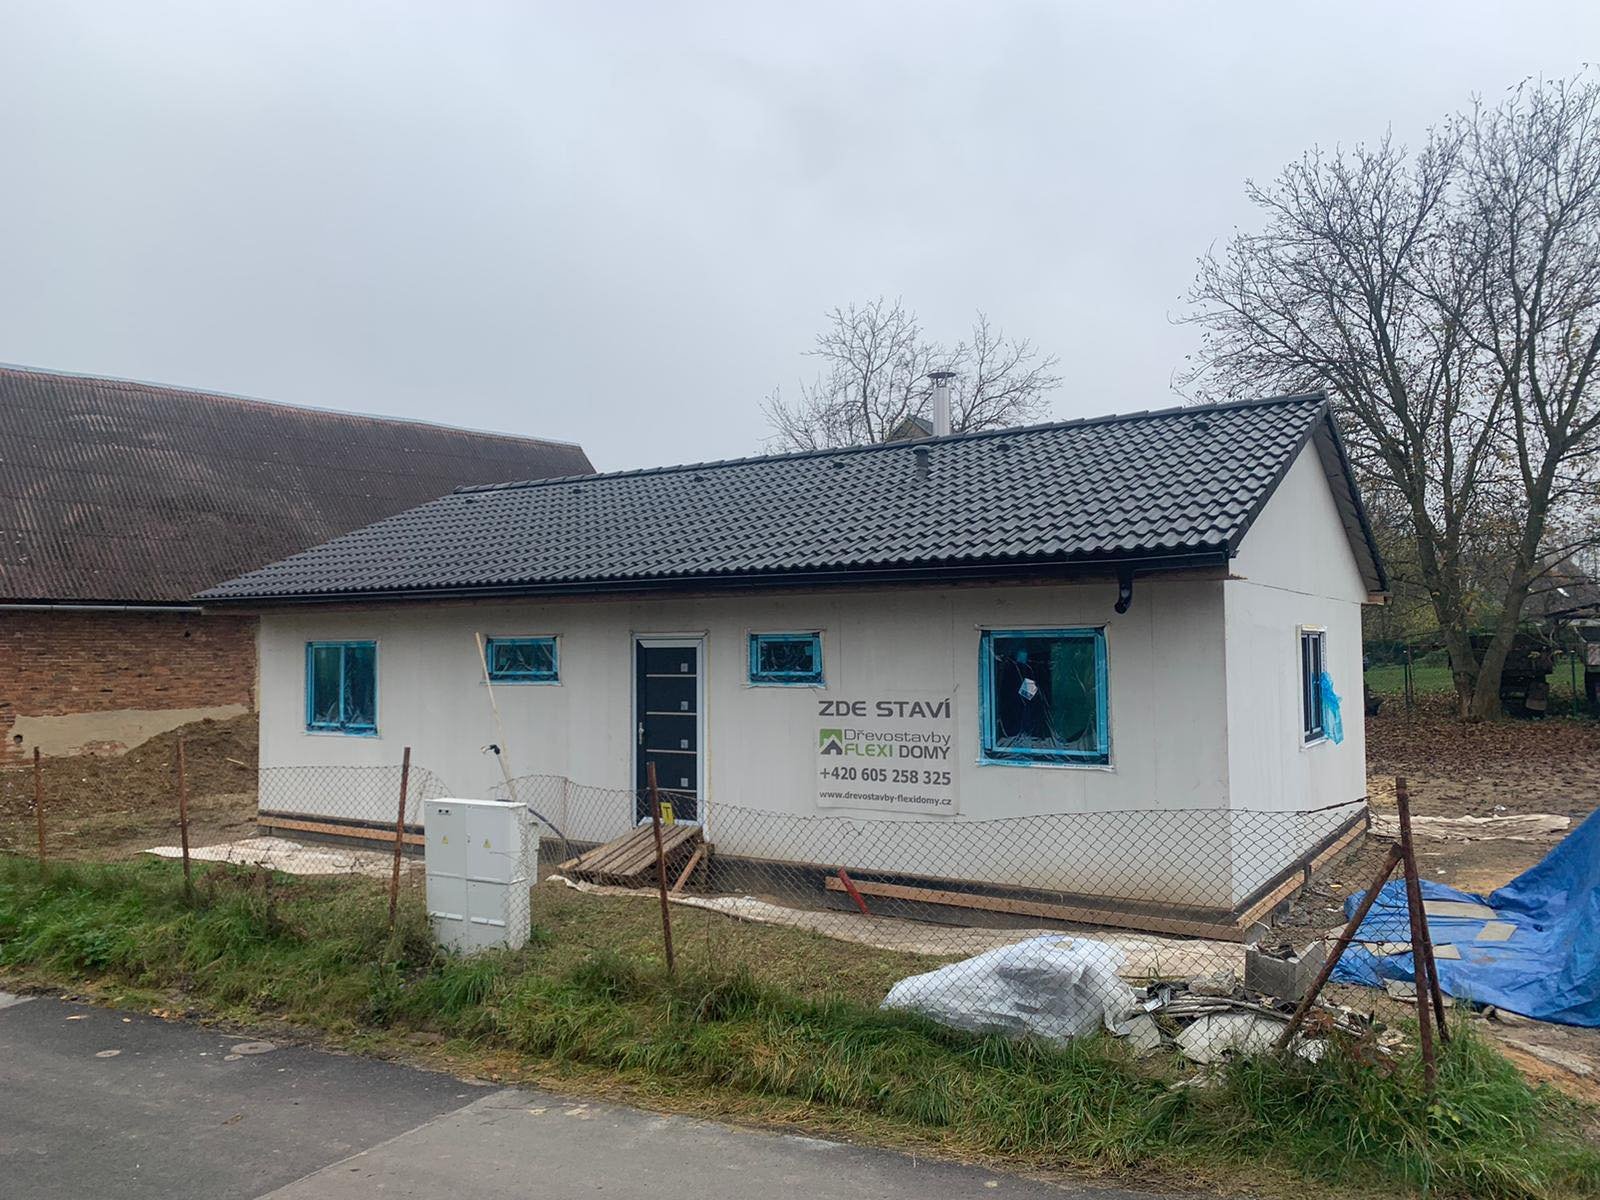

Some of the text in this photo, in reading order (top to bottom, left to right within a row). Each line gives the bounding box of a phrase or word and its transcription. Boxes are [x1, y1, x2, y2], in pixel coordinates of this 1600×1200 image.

[818, 698, 951, 718] ZDE STAVÍ
[844, 728, 951, 746] Dřevostavby
[844, 744, 950, 760] FLEXI DOMY
[820, 767, 951, 785] +420 605 258 325
[819, 791, 952, 806] www.drevostavby-flexidomy.cz
